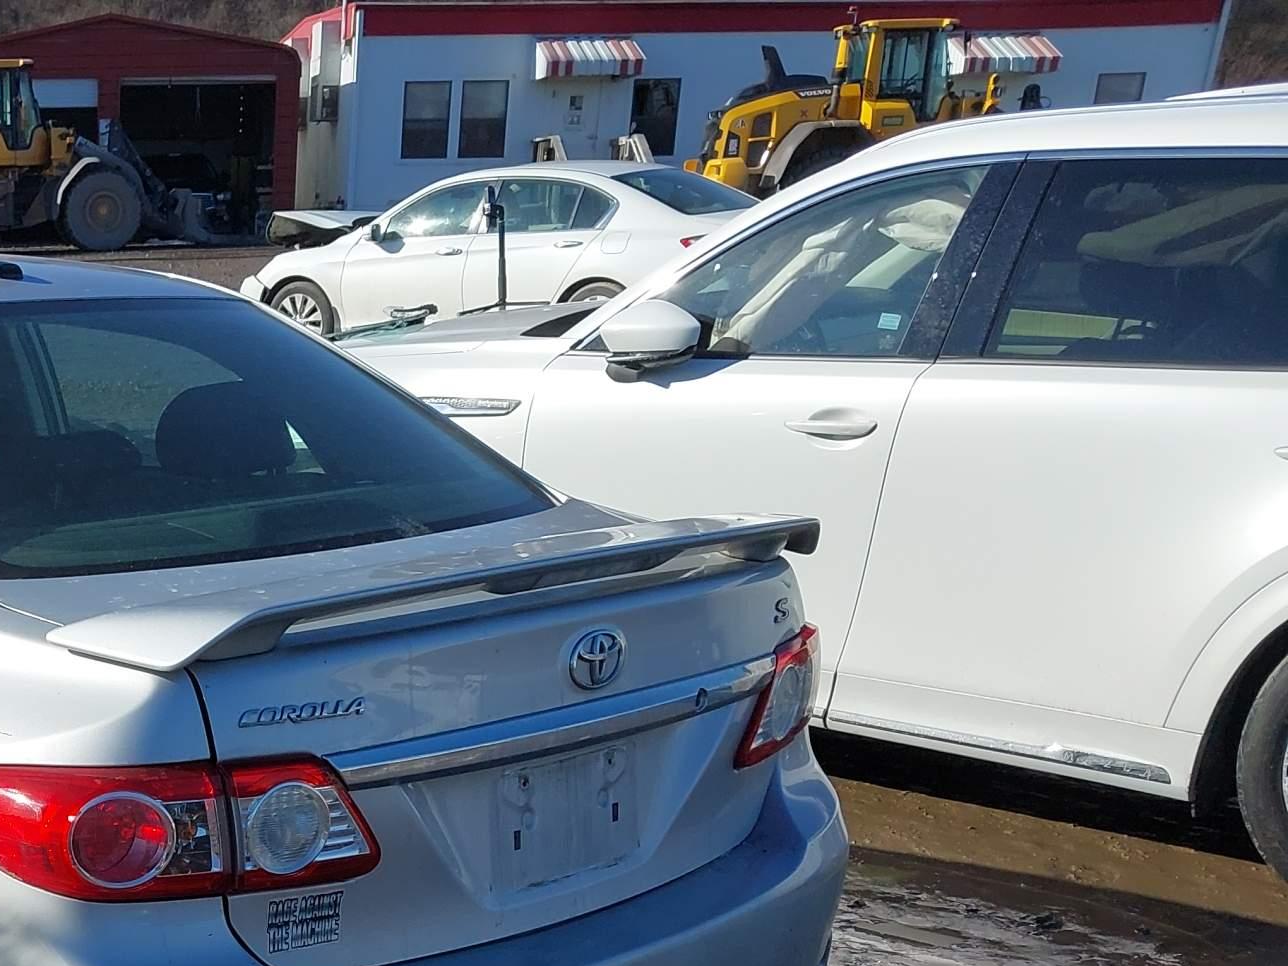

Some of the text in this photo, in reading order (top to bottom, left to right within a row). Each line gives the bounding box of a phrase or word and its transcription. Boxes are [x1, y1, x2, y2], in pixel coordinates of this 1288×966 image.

[798, 89, 832, 97] VOLVO
[773, 597, 790, 624] S
[238, 696, 366, 728] COROLLA
[268, 891, 344, 925] RAGE AGAINST
[267, 917, 340, 953] THE MACHINE
